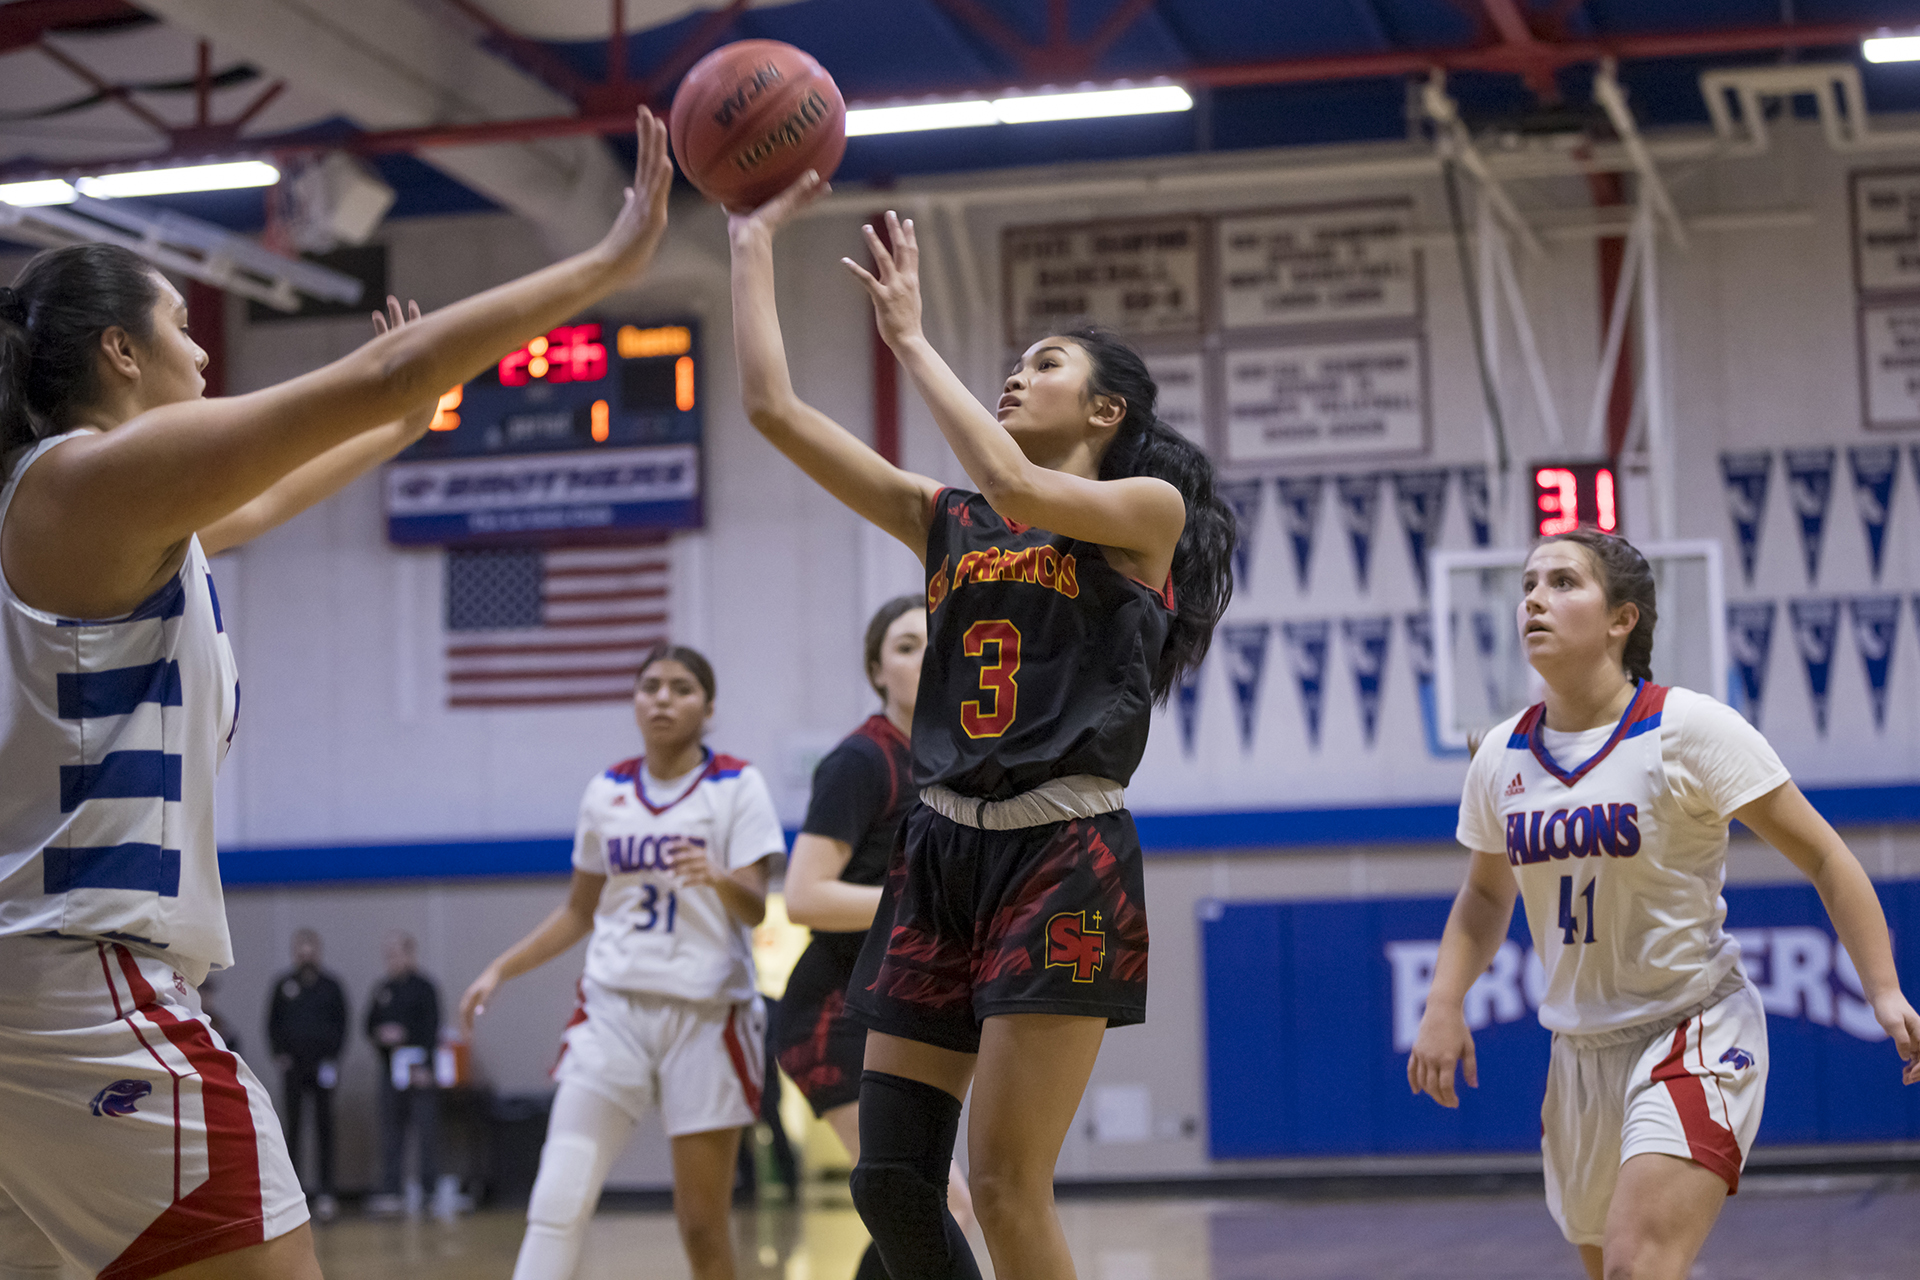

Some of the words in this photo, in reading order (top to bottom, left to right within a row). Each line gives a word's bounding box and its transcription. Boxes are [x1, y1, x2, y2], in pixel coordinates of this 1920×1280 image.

[1536, 468, 1616, 536] 31
[952, 545, 1079, 599] FRANCIS
[961, 619, 1021, 739] 3
[1506, 803, 1641, 866] FALCONS
[634, 883, 677, 933] 31
[1558, 875, 1597, 944] 41
